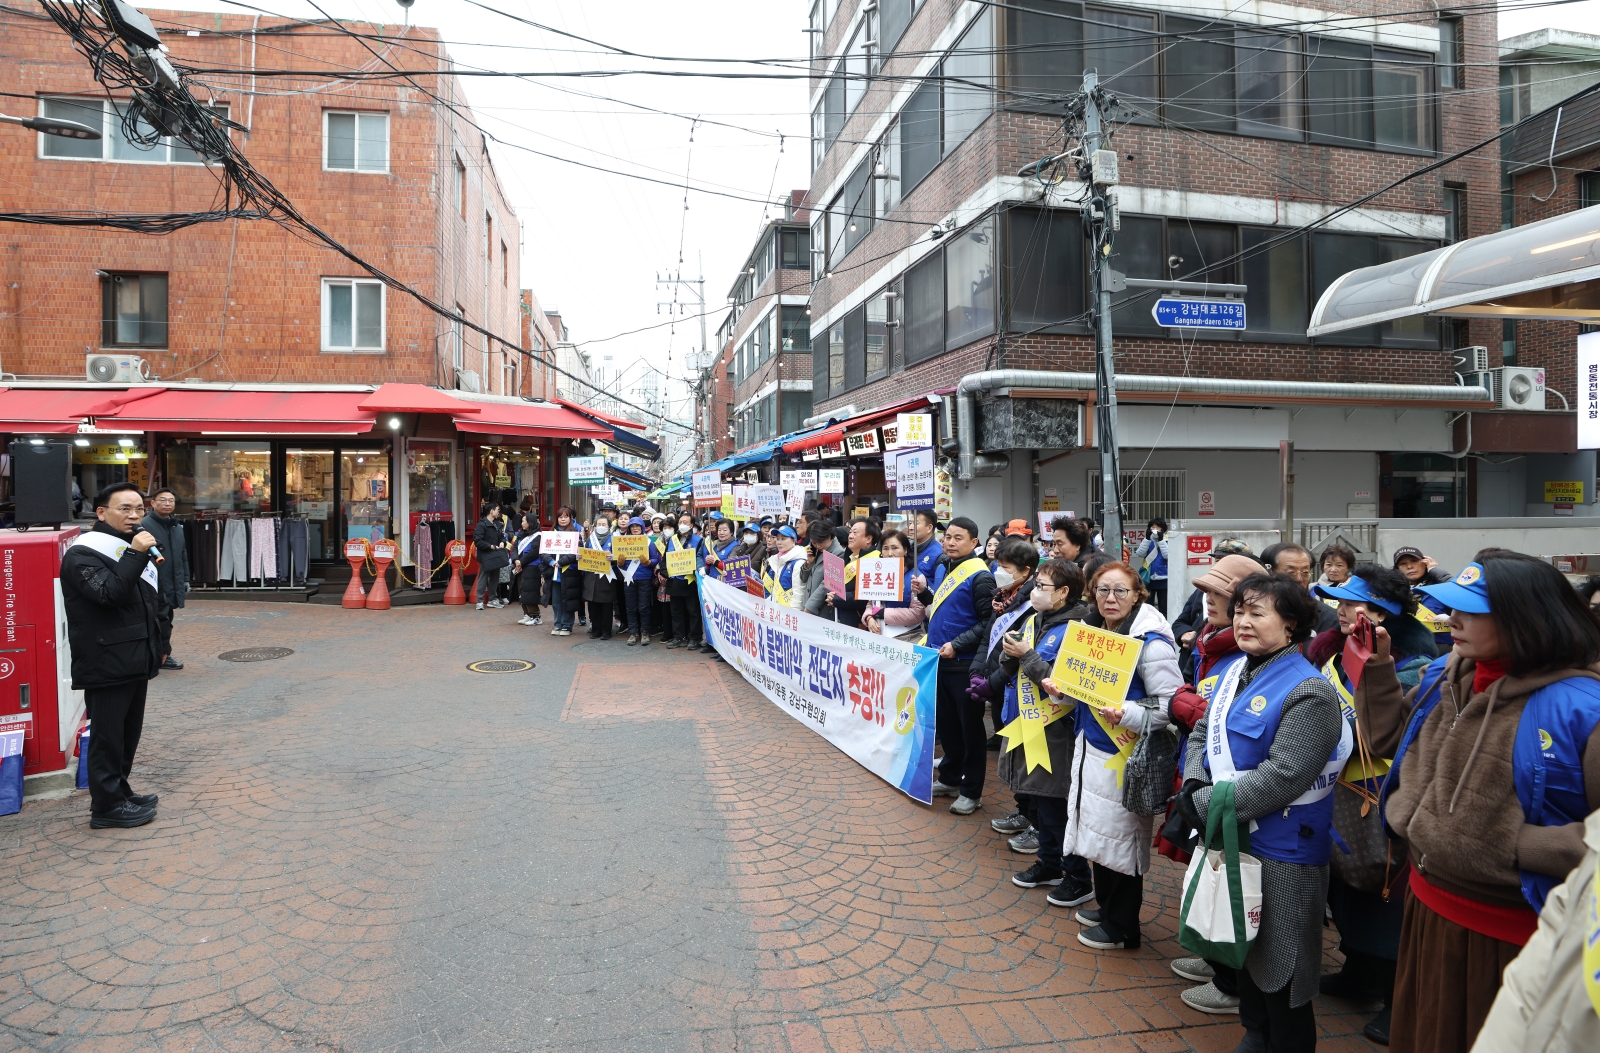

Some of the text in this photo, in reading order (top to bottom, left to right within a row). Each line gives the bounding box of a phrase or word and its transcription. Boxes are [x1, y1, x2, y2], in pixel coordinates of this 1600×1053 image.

[1181, 304, 1242, 318] 강남대로126길
[1174, 316, 1242, 328] Gangnam-daero 126-gil
[1588, 364, 1598, 418] 영동전통시장
[737, 498, 754, 510] 불조심
[545, 539, 572, 548] 불조심
[862, 572, 895, 590] 불조심
[4, 549, 16, 642] Emergency Fire Hydrant
[842, 633, 866, 651] 함께하는
[1076, 629, 1127, 656] 불법전단지
[1088, 648, 1105, 661] NO
[758, 622, 766, 663] &
[808, 644, 845, 706] 전단지
[846, 660, 886, 728] 추방!!
[1065, 656, 1119, 686] 깨끗한 거리문화
[1079, 676, 1097, 691] YES
[752, 668, 826, 728] 바르게살기운동 강남구협의회
[1020, 708, 1040, 720] YES
